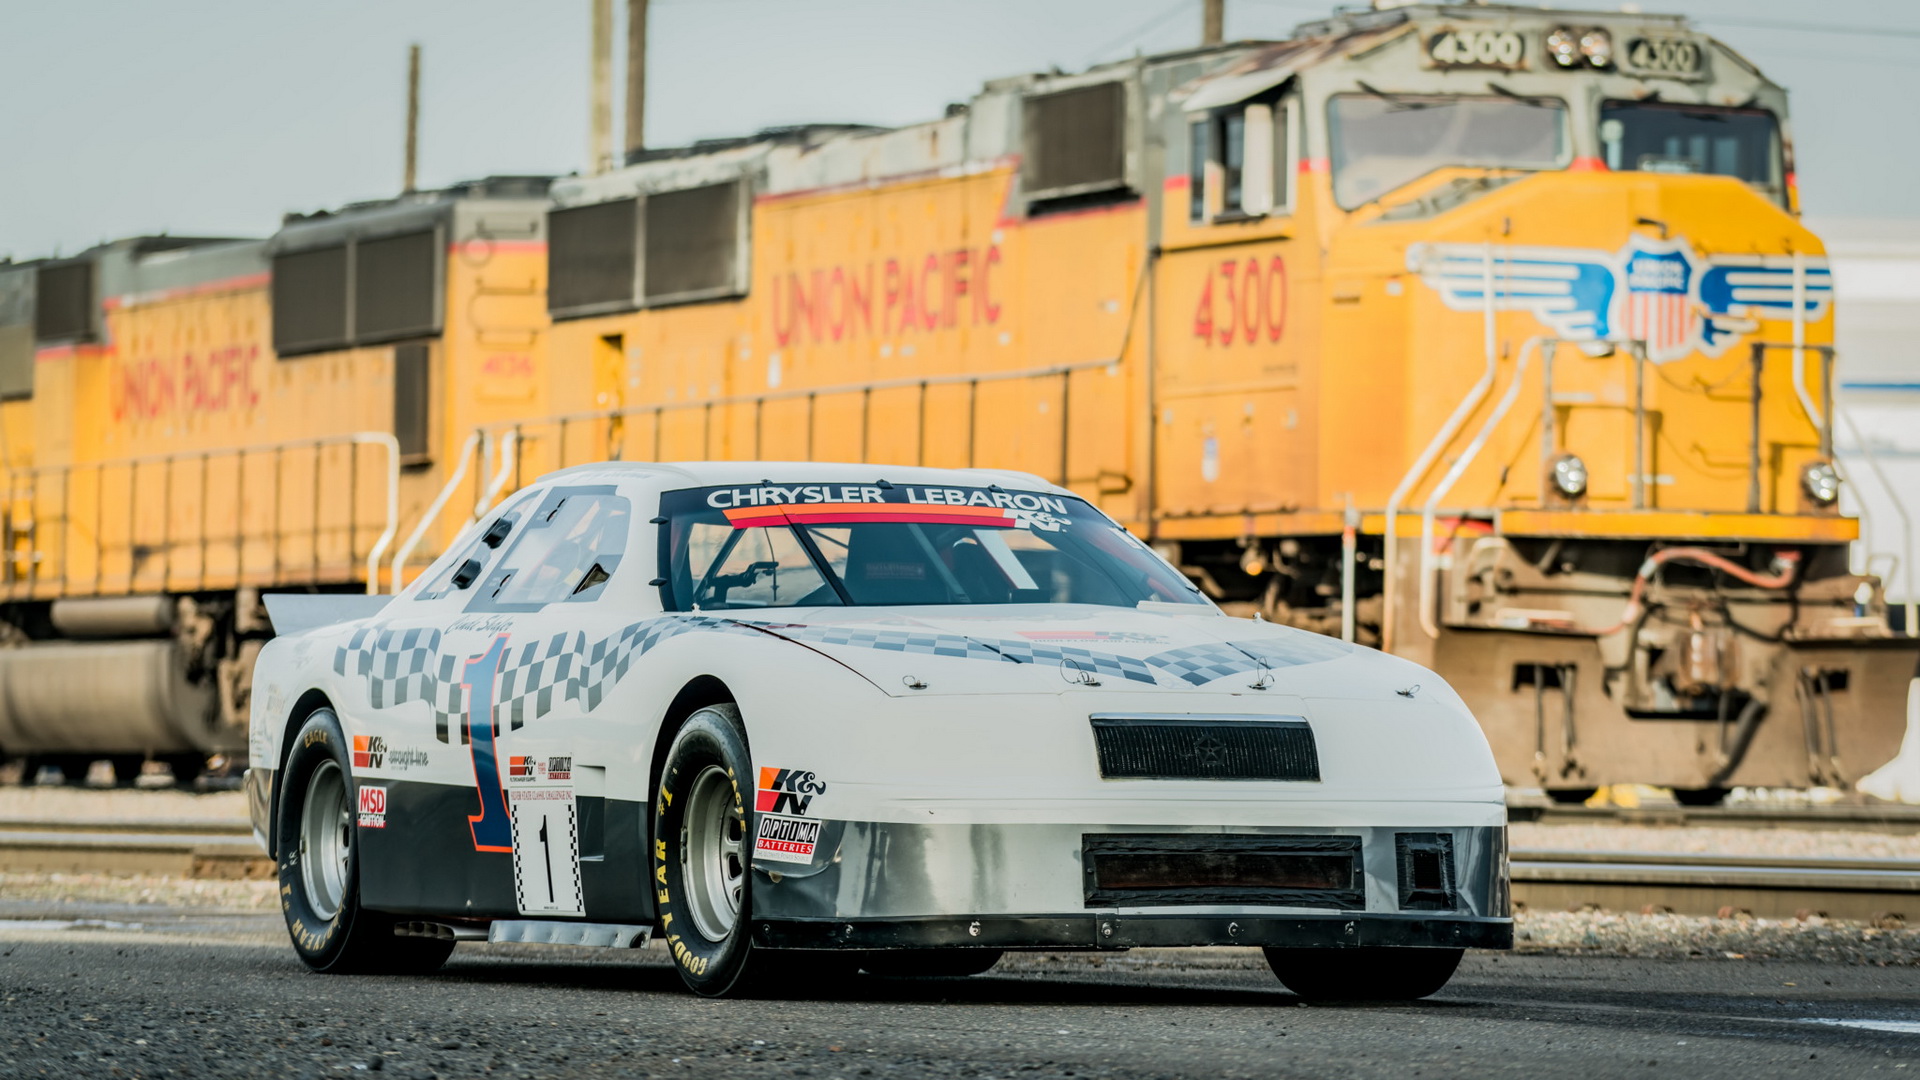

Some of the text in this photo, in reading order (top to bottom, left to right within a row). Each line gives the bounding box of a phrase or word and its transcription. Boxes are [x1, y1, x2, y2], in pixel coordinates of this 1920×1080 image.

[1432, 31, 1522, 64] 4300
[1632, 37, 1698, 72] 4300
[772, 244, 1002, 348] UNION PACIFIC
[1193, 254, 1288, 347] 4300
[706, 486, 1068, 514] CHRYSLER LEBARON
[304, 728, 328, 749] EAGLE
[460, 632, 513, 854] 1
[360, 788, 385, 813] MSD
[728, 766, 747, 833] EAGLE
[758, 840, 813, 853] BATTERIES
[761, 818, 818, 843] OPTIMA
[539, 814, 554, 903] 1
